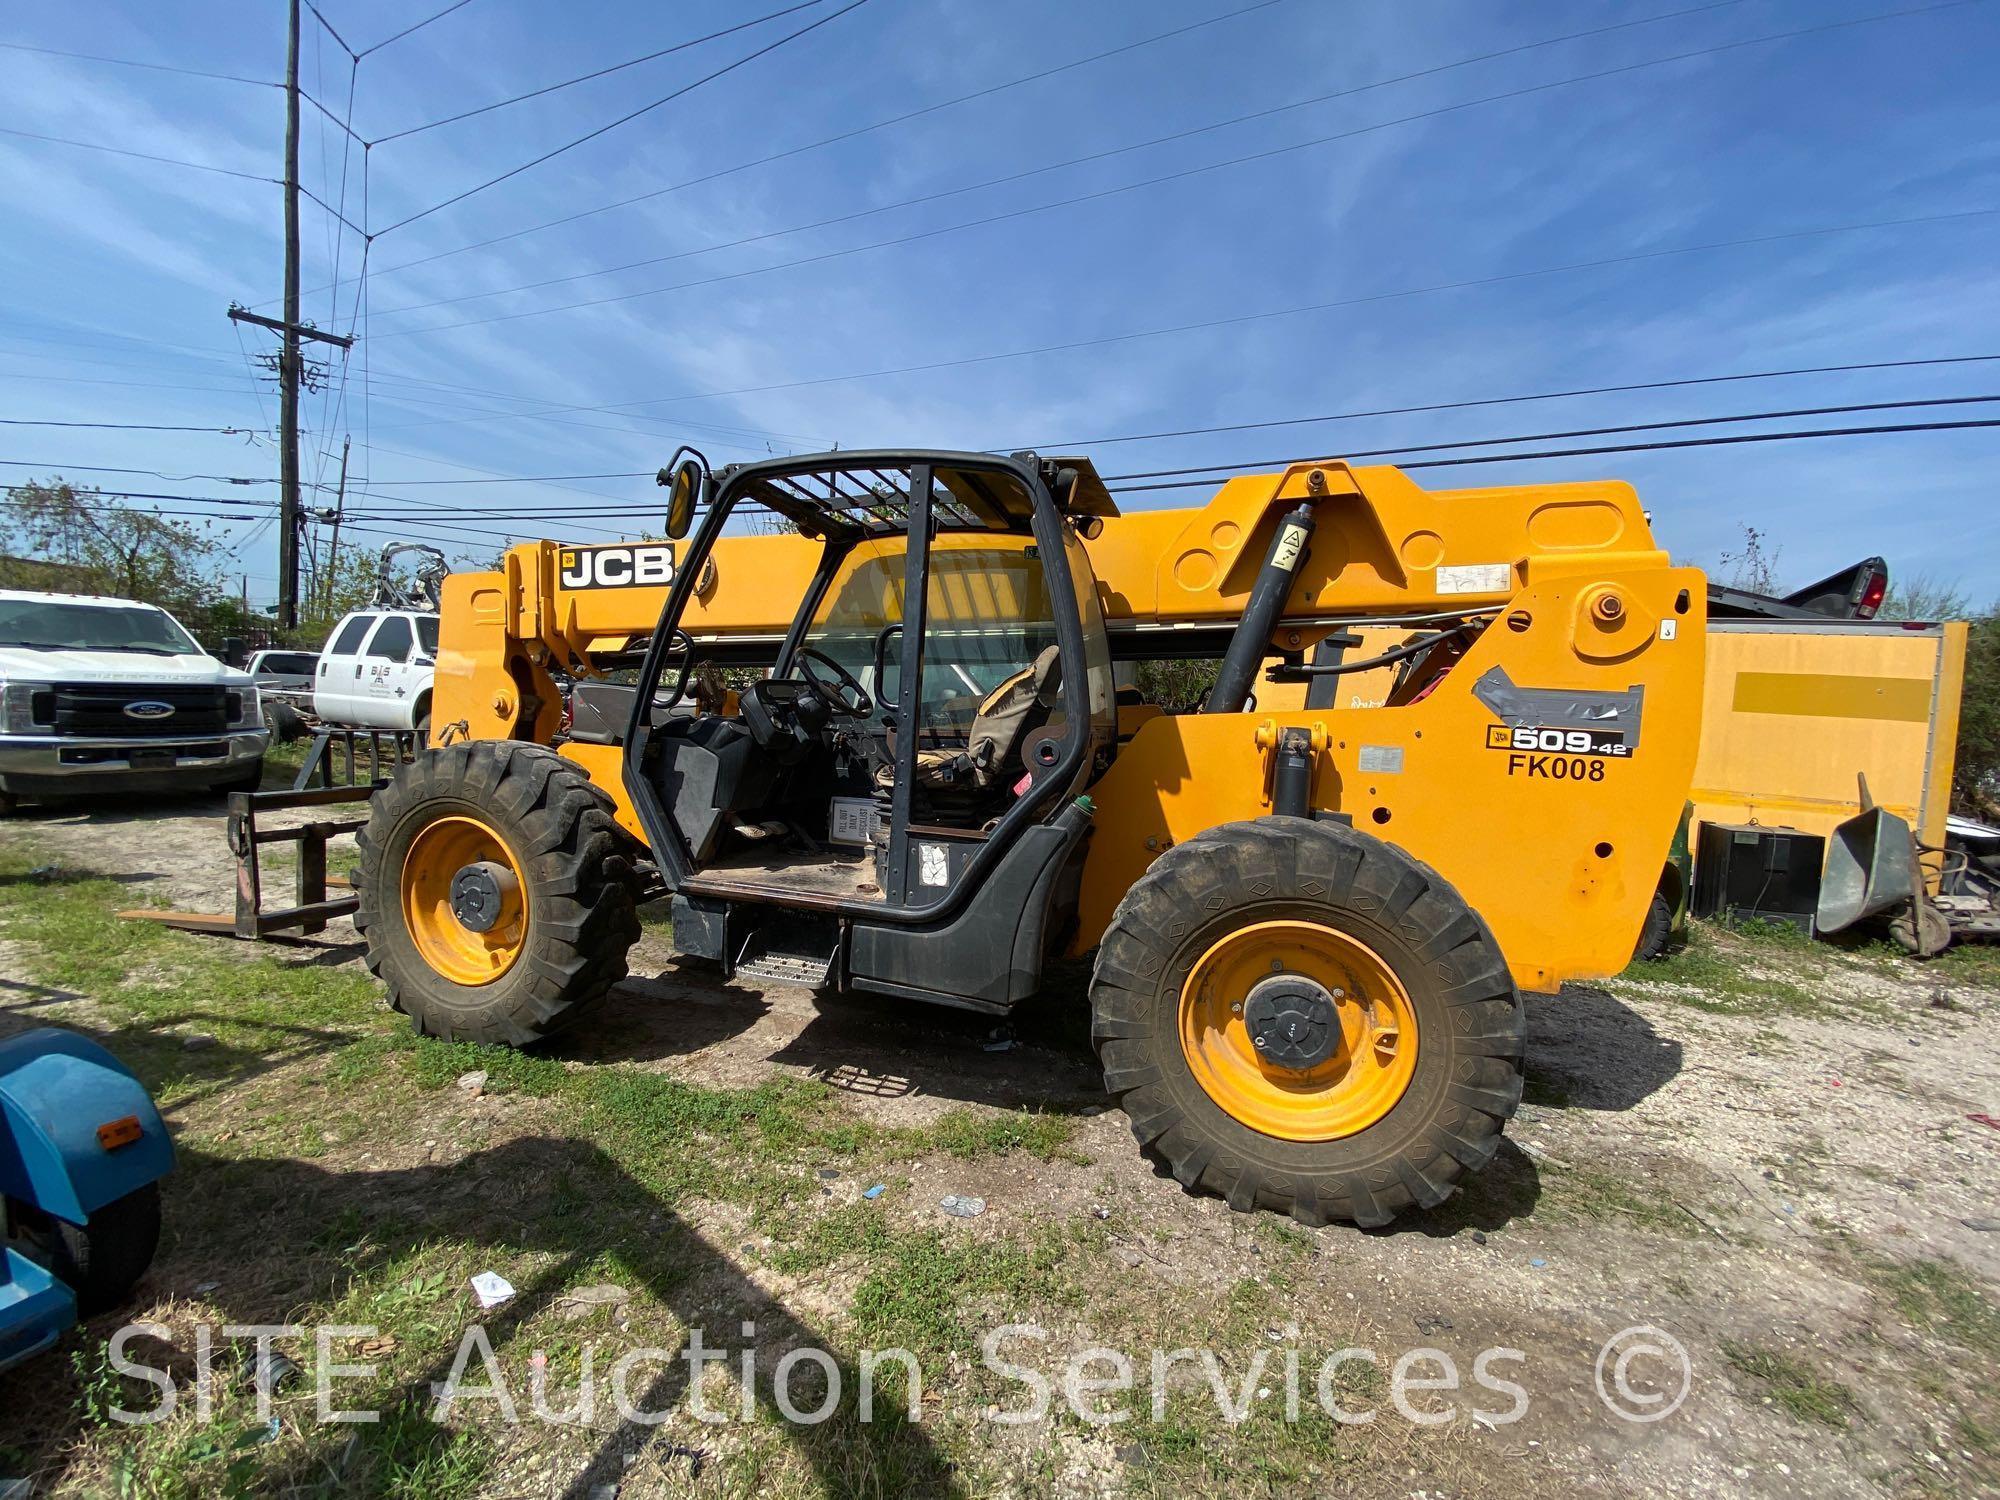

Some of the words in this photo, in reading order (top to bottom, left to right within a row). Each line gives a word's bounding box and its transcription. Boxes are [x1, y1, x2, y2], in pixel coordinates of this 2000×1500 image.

[562, 547, 674, 587] JCB
[1508, 754, 1606, 782] FK008
[840, 809, 848, 821] OUT
[839, 821, 847, 833] FILL
